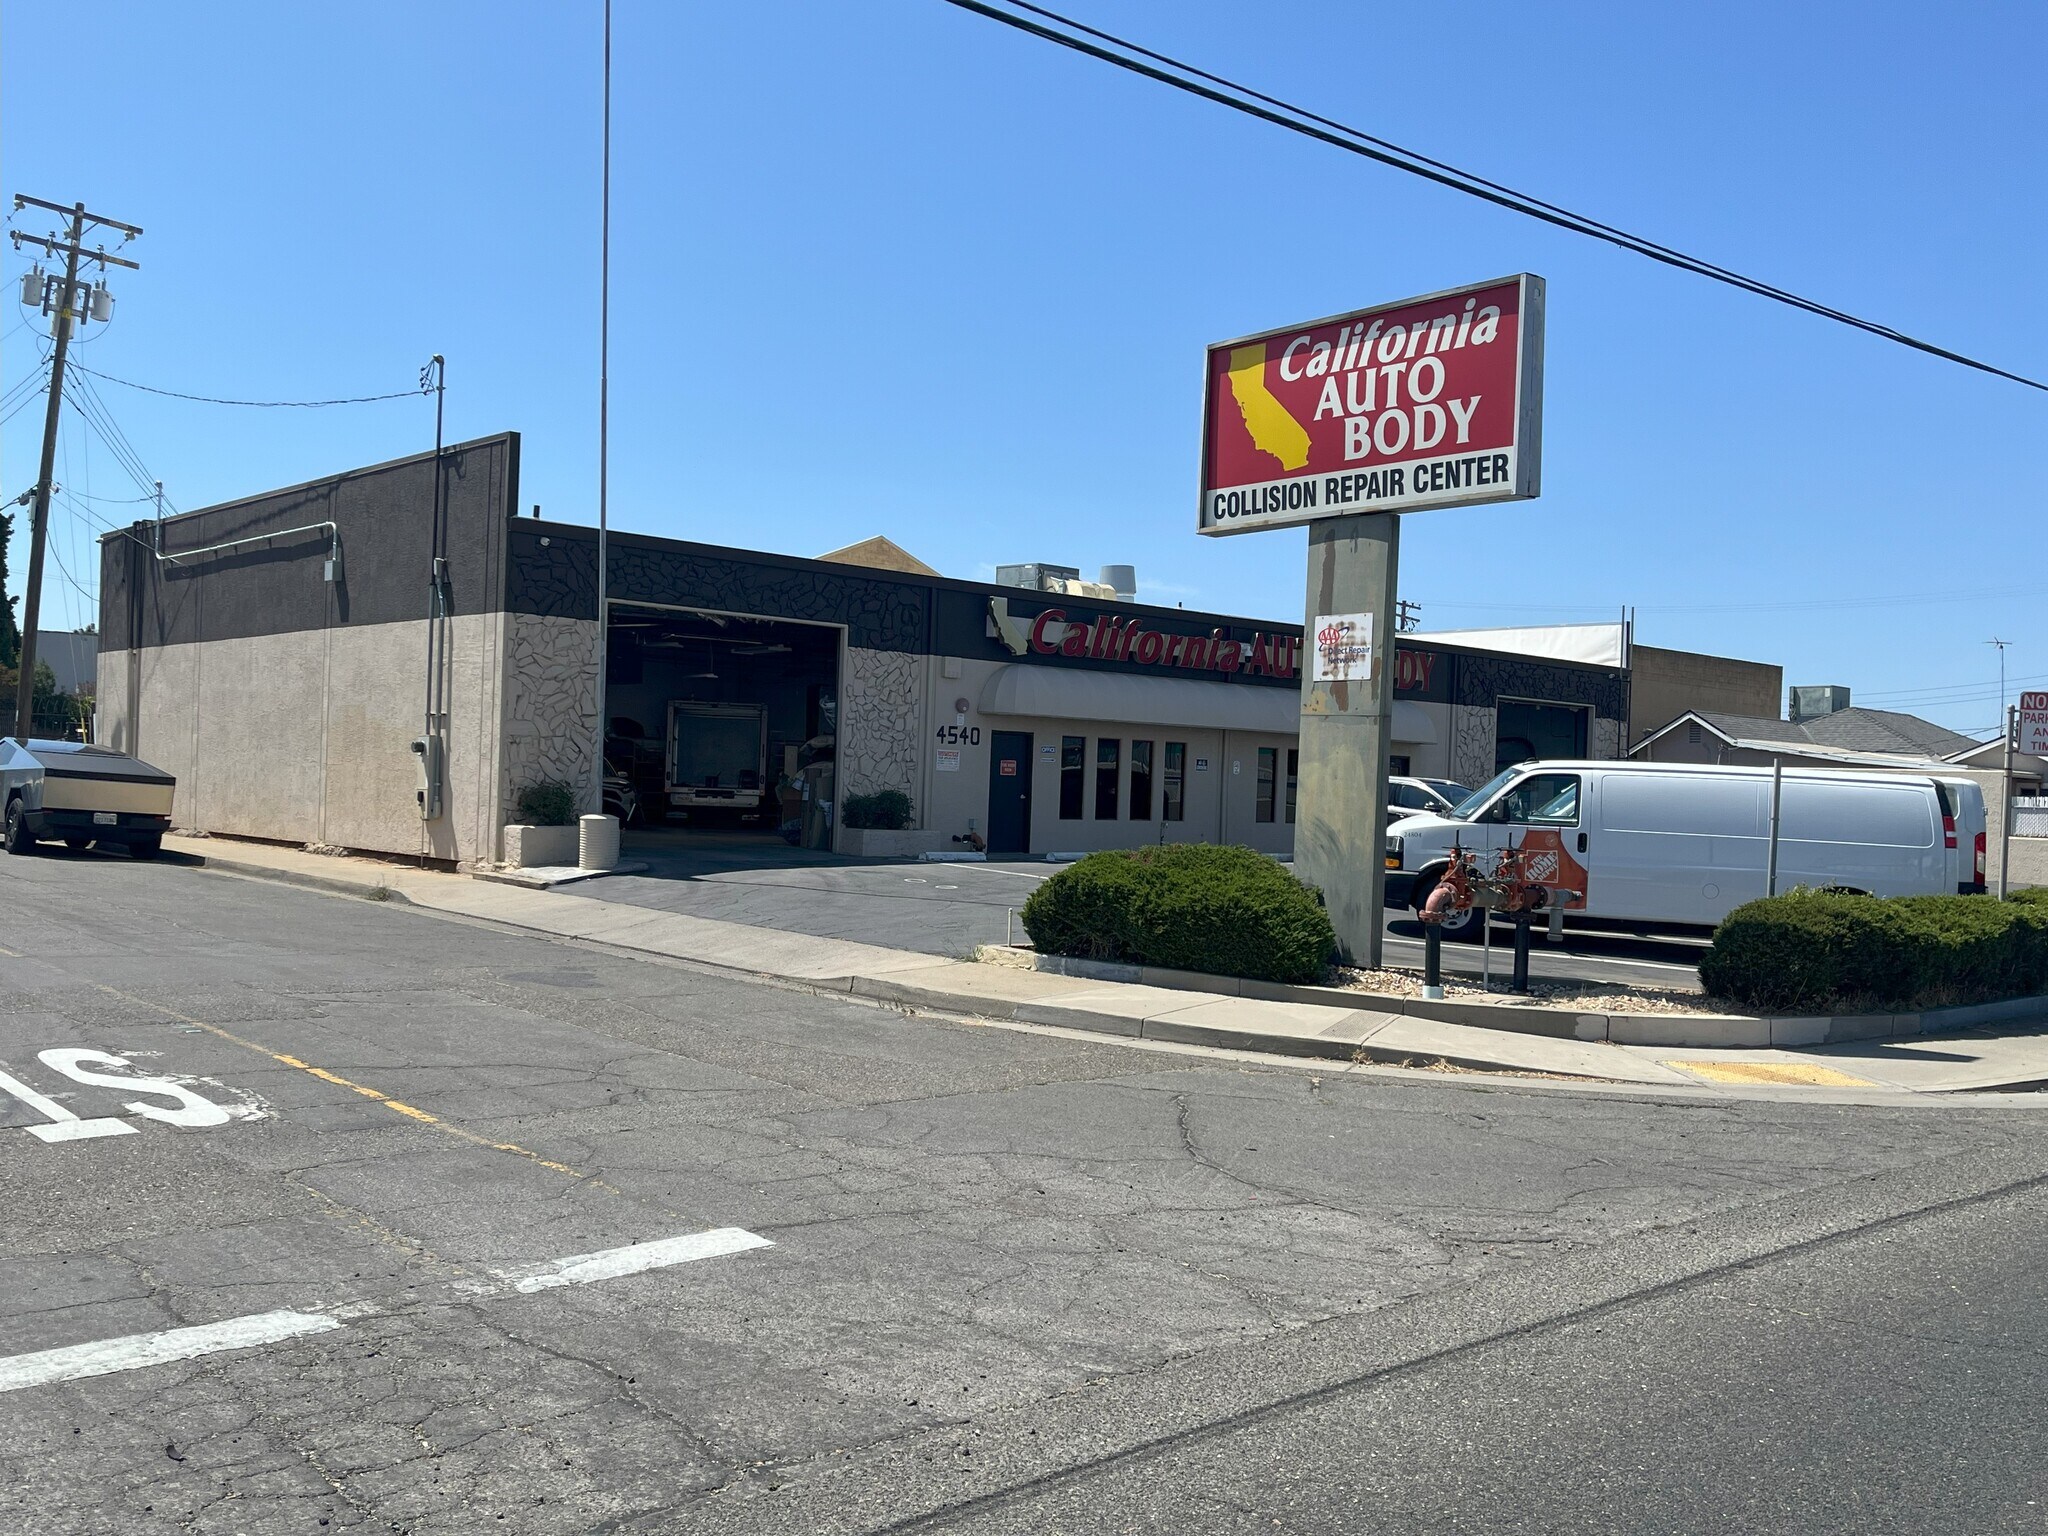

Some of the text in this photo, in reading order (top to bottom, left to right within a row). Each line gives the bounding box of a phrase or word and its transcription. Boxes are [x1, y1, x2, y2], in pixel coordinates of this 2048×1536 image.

[1279, 297, 1502, 382] California
[1313, 356, 1446, 421] AUTO
[1344, 395, 1482, 462] BODY
[1213, 453, 1510, 520] COLLISION REPAIR CENTER
[1319, 628, 1339, 645] AAA
[1029, 609, 1438, 693] California AU DY
[1328, 646, 1371, 656] Direct Repair
[1328, 657, 1357, 665] Network
[2023, 694, 2048, 709] NO
[936, 725, 980, 746] 4540
[1526, 851, 1558, 881] HOME
[1530, 853, 1545, 866] THE
[1537, 863, 1558, 881] DEPOT
